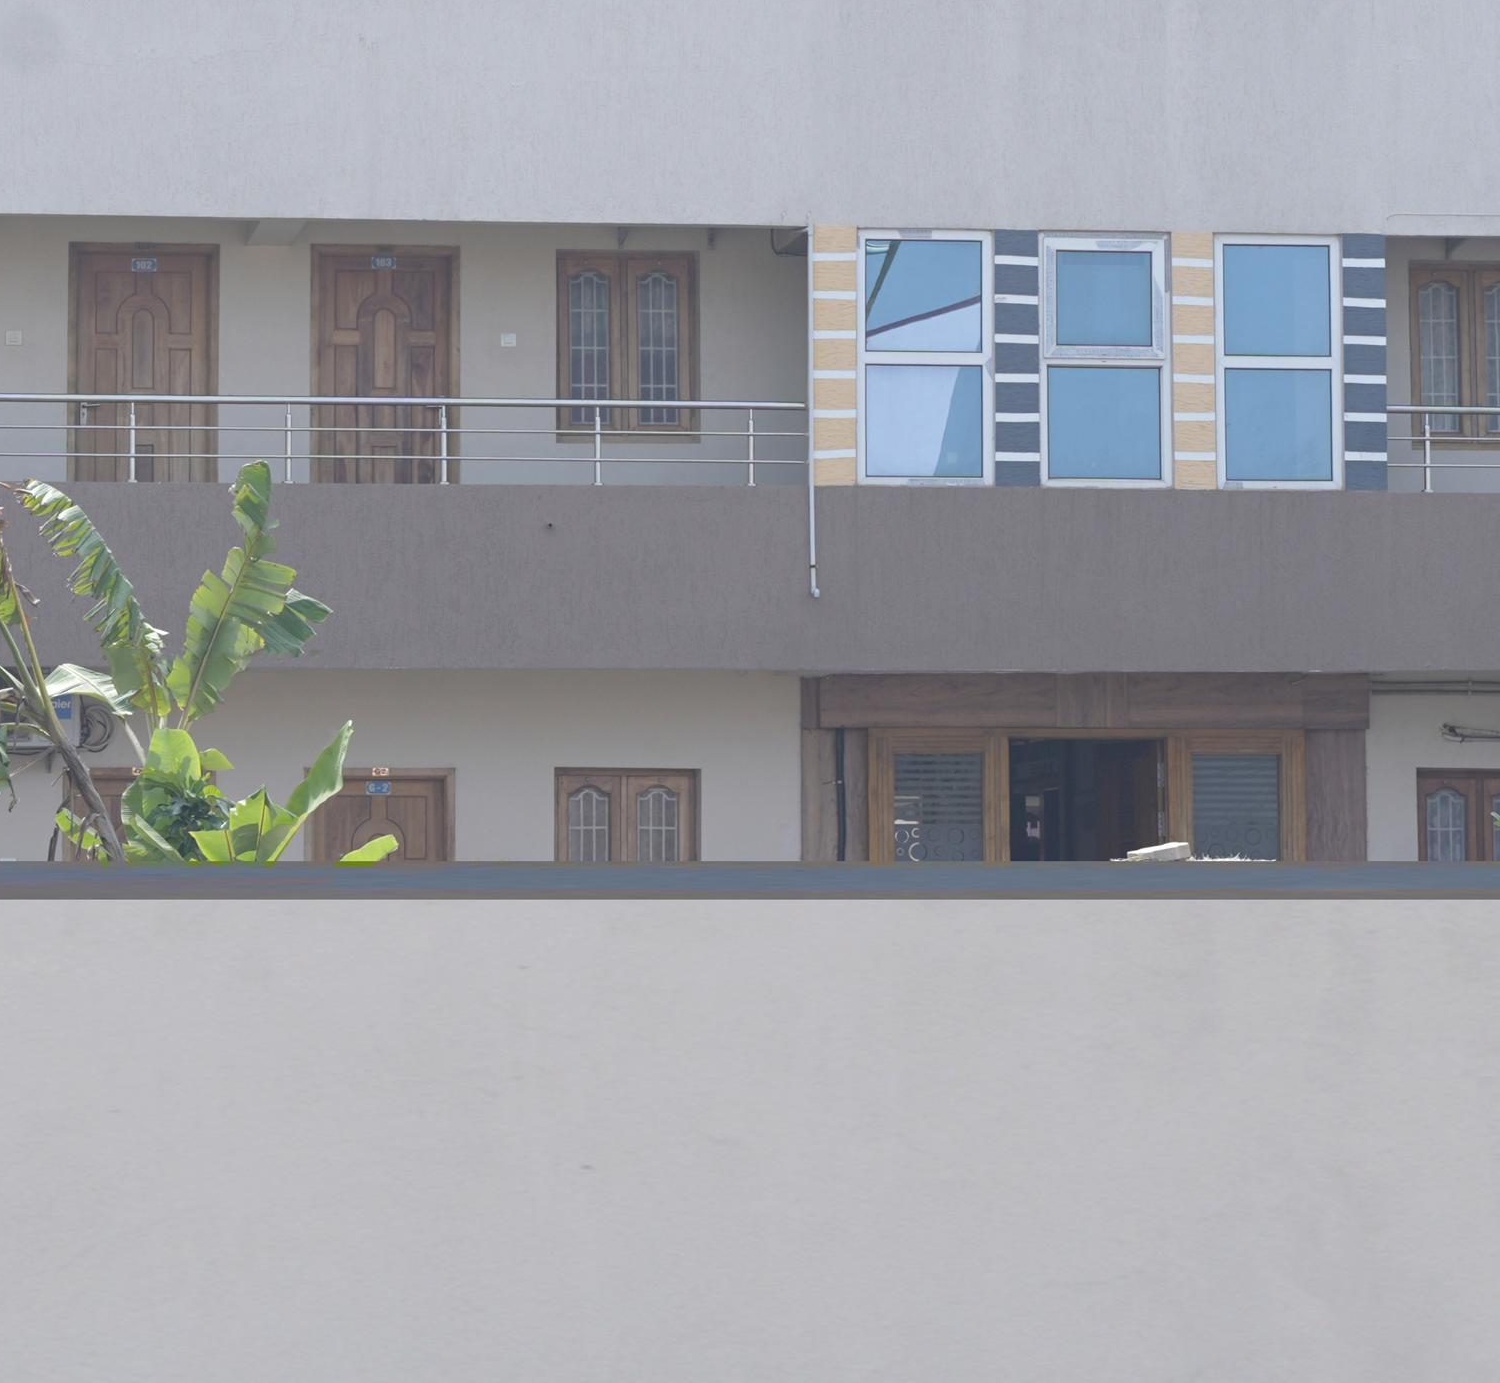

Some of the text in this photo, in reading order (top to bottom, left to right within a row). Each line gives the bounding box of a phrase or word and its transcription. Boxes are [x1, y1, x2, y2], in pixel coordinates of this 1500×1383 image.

[135, 260, 153, 270] 102
[375, 256, 392, 267] 103
[368, 782, 389, 793] G-2
